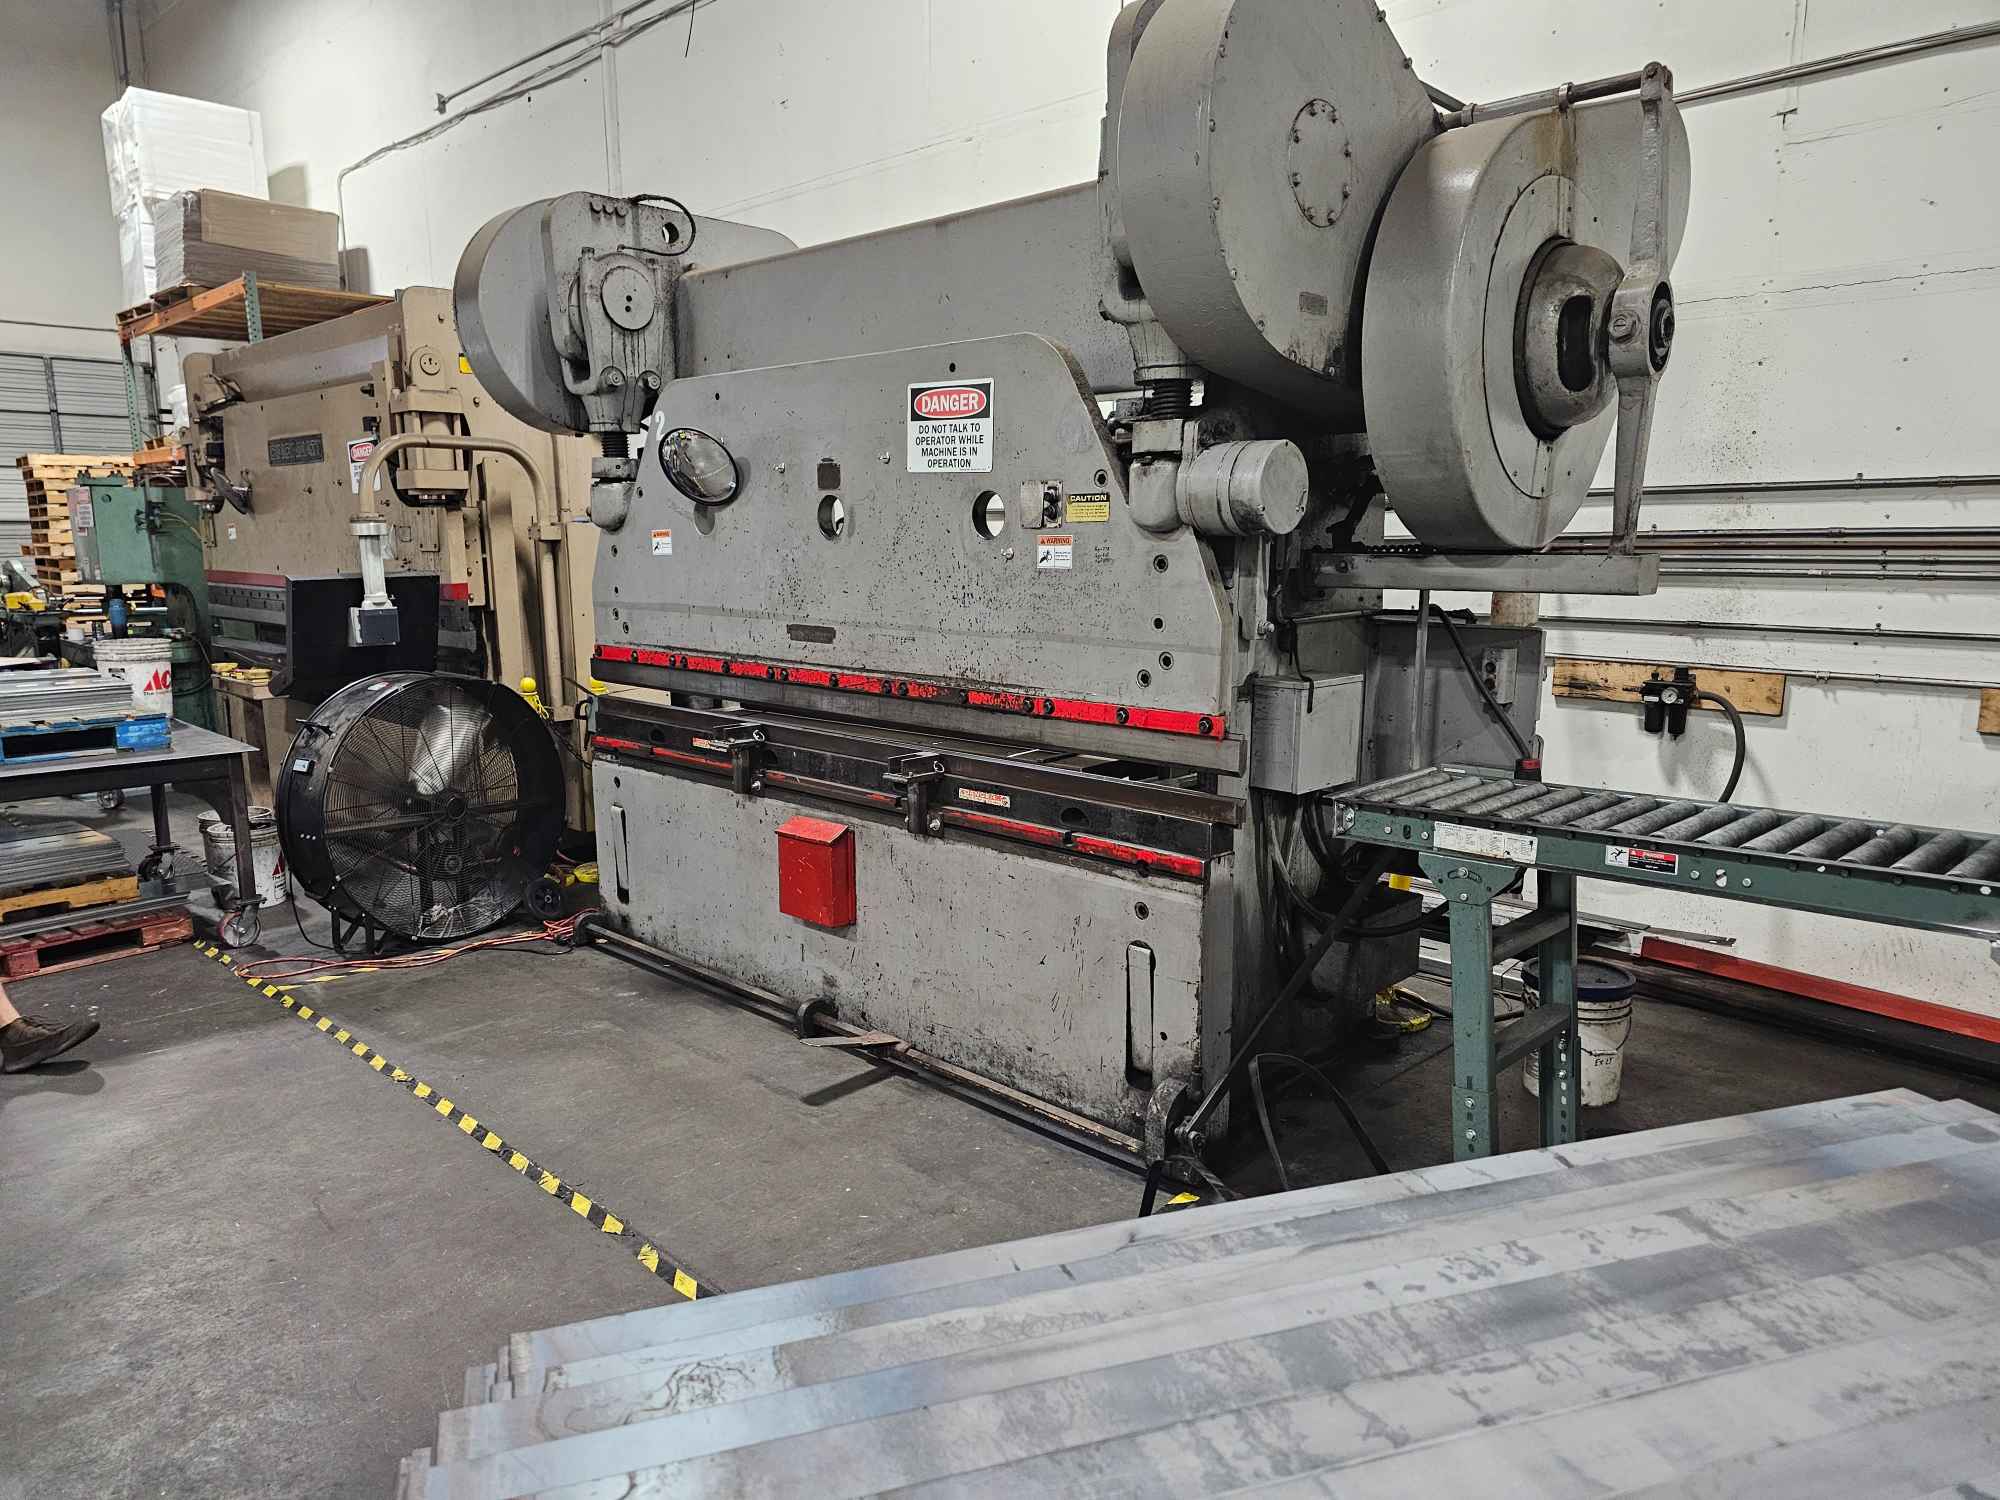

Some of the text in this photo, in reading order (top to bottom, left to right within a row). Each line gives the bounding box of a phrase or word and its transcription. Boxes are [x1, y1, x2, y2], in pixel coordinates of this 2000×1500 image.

[921, 393, 979, 412] DANGER
[655, 410, 665, 441] 2
[918, 423, 980, 434] DO NOT TALK TO
[915, 435, 984, 445] OPERATOR WHILE
[921, 447, 978, 457] MACHINE IS IN
[927, 459, 971, 468] OPERATION
[1070, 494, 1107, 502] CAUTION
